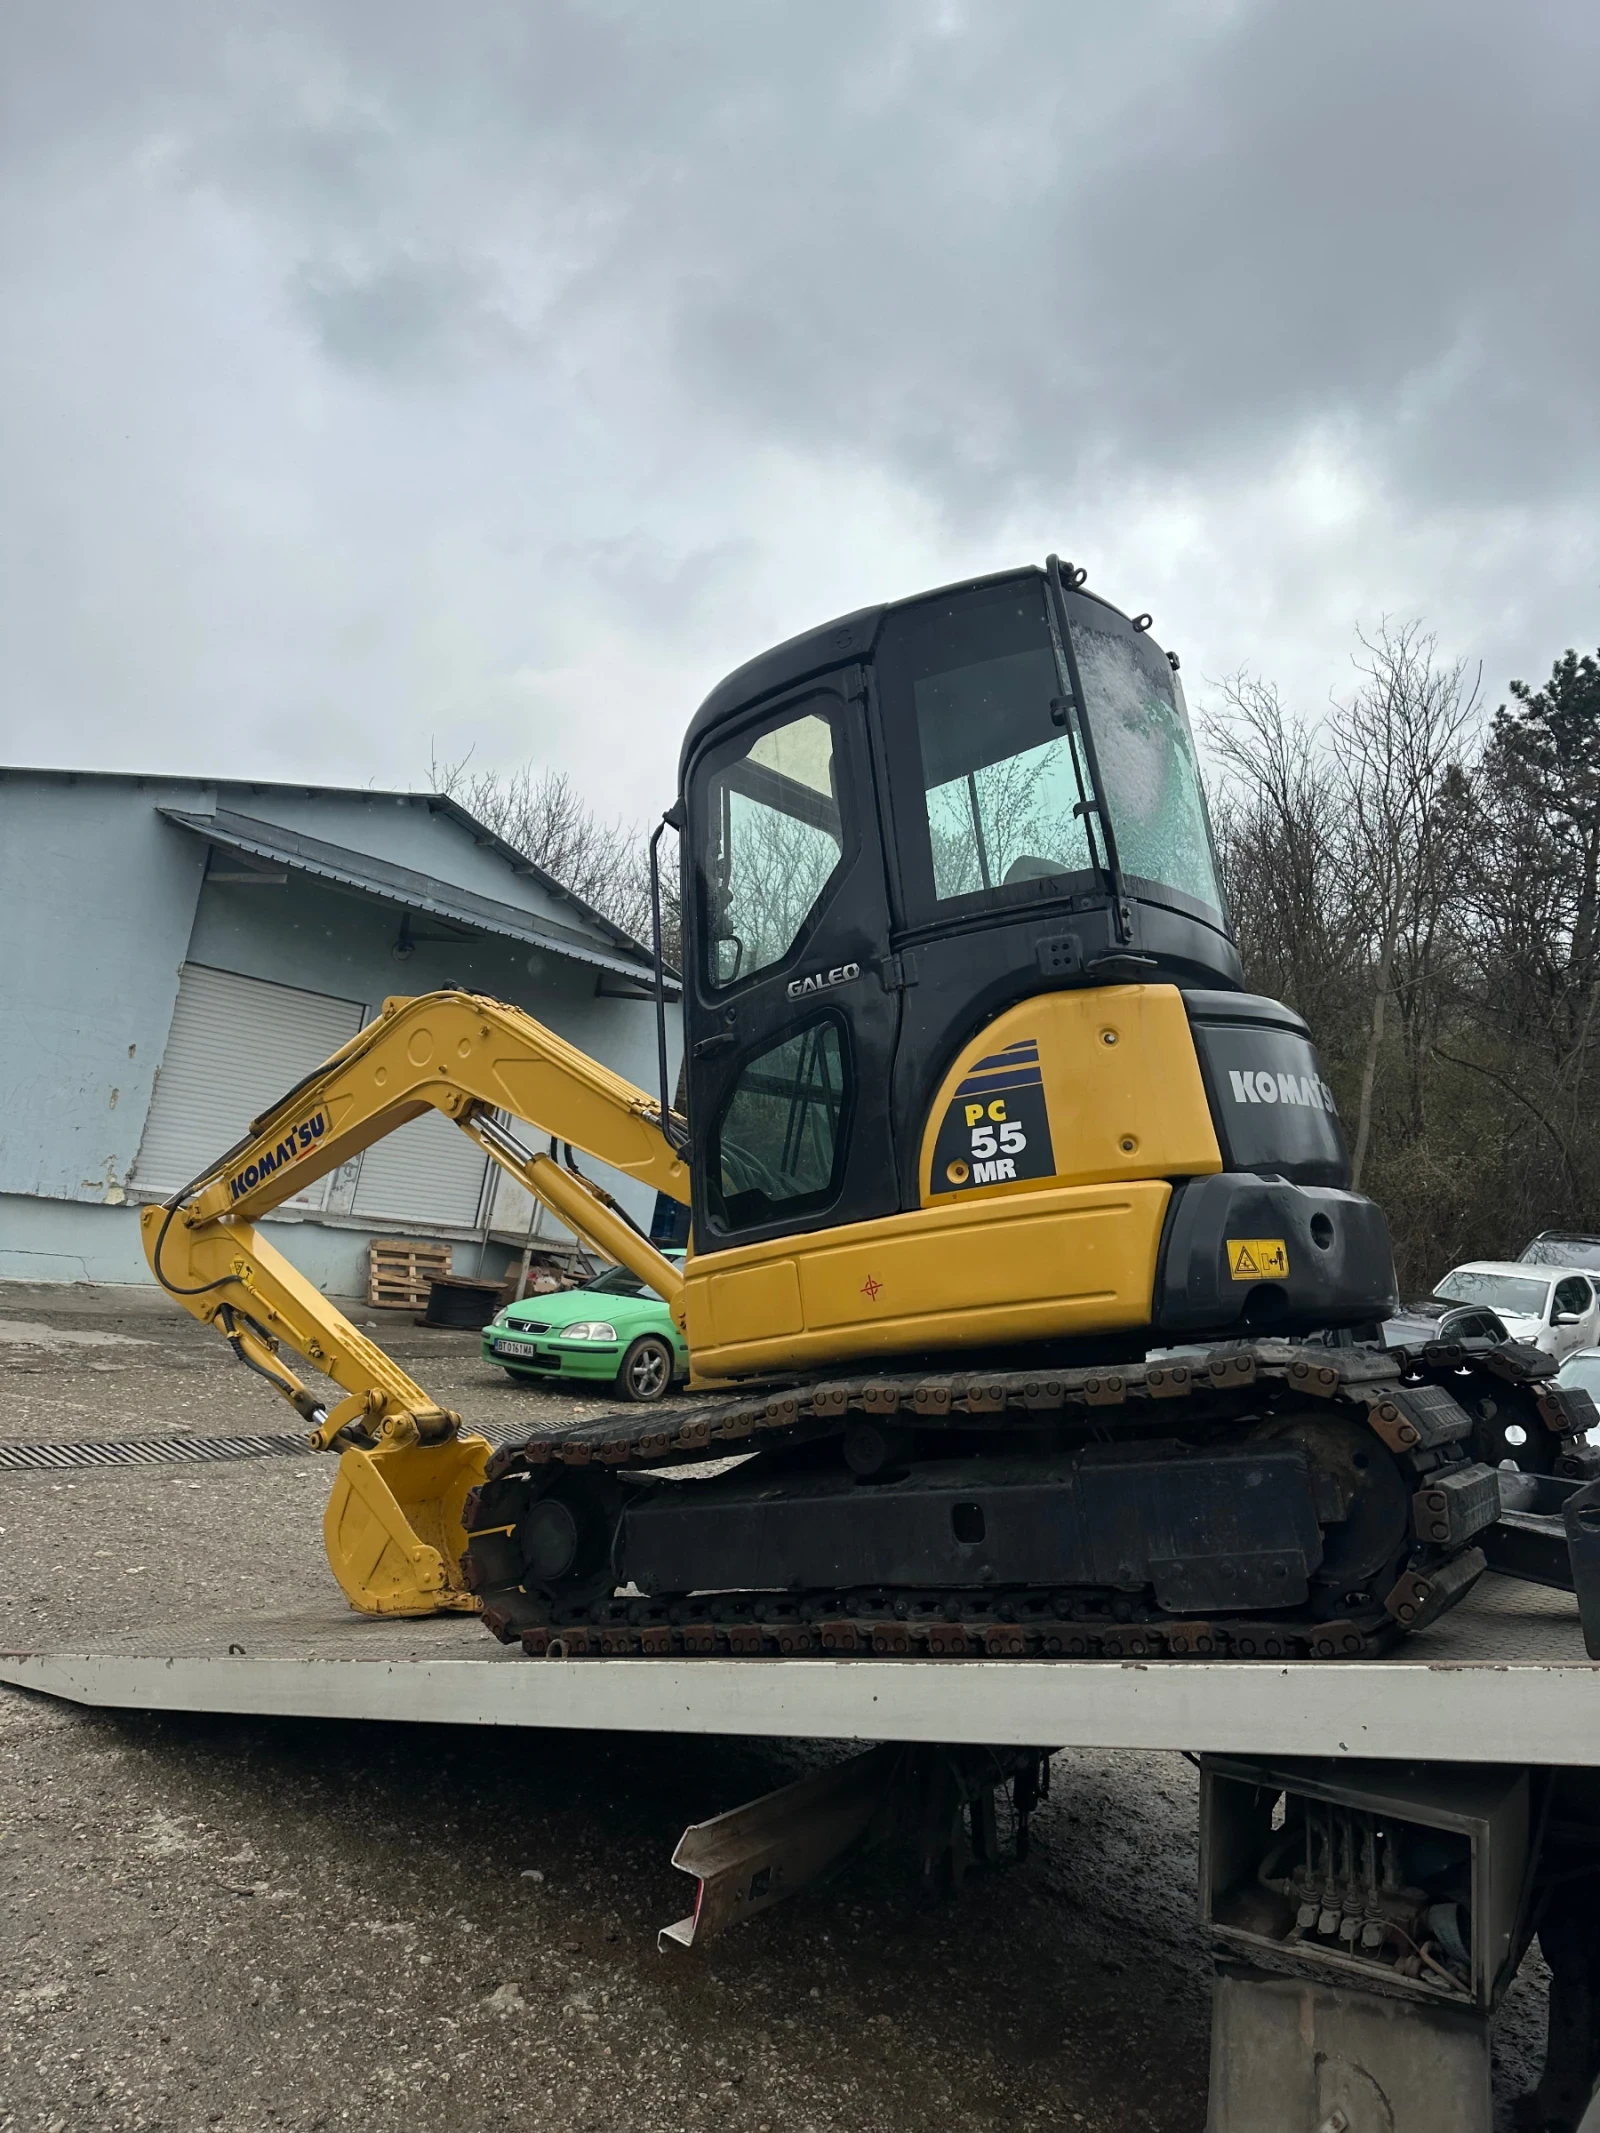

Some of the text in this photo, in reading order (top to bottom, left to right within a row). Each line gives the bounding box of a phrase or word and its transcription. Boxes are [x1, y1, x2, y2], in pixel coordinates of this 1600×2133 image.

[787, 963, 860, 997] GALEO
[965, 1099, 1006, 1127] PC
[230, 1112, 325, 1200] KOMATSU
[971, 1121, 1027, 1158] 55
[972, 1158, 1017, 1184] MR
